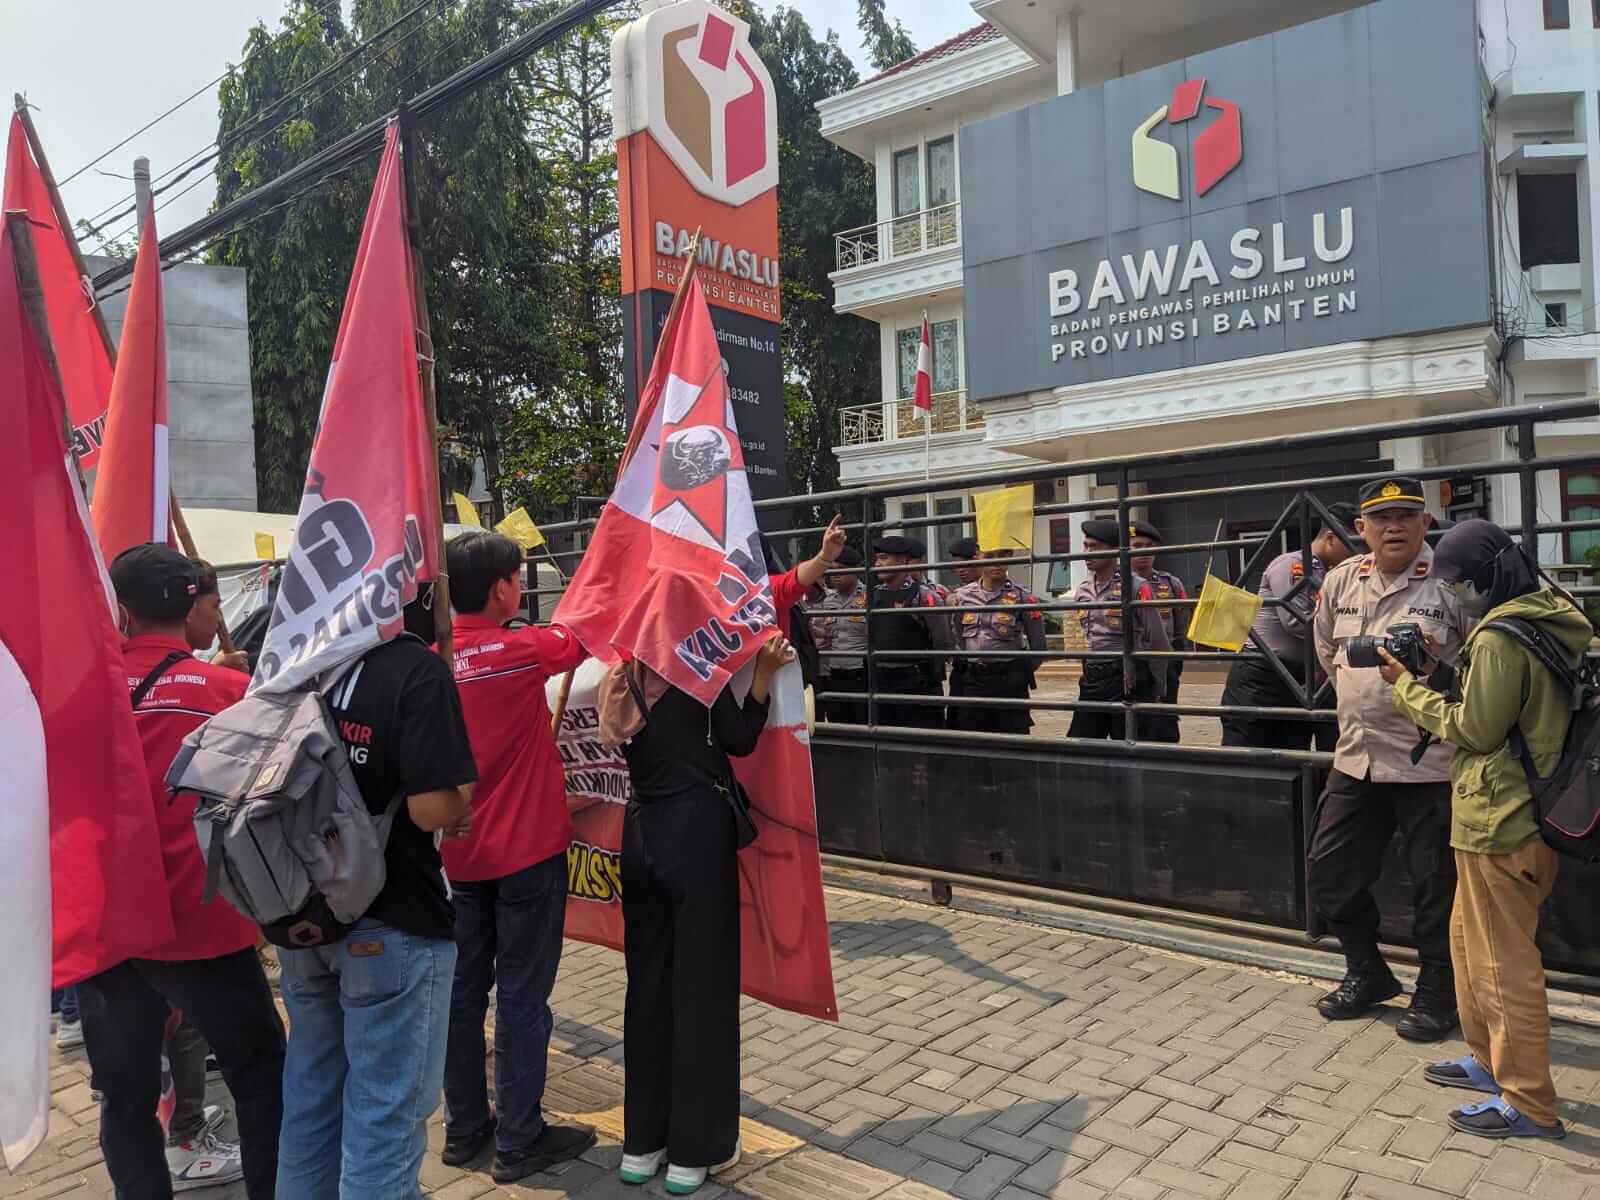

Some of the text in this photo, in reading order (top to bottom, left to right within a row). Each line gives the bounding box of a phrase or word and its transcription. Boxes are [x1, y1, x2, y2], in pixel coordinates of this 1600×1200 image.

[655, 220, 779, 289] BAWASLU
[1048, 206, 1354, 317] BAWASLU
[728, 291, 778, 316] BANTEN
[1051, 267, 1356, 337] BADAN PENGAWAS PEMILIHAN UMUM
[1051, 290, 1357, 363] PROVINSI BANTEN
[730, 387, 761, 405] 83482
[1407, 607, 1445, 620] POLRI
